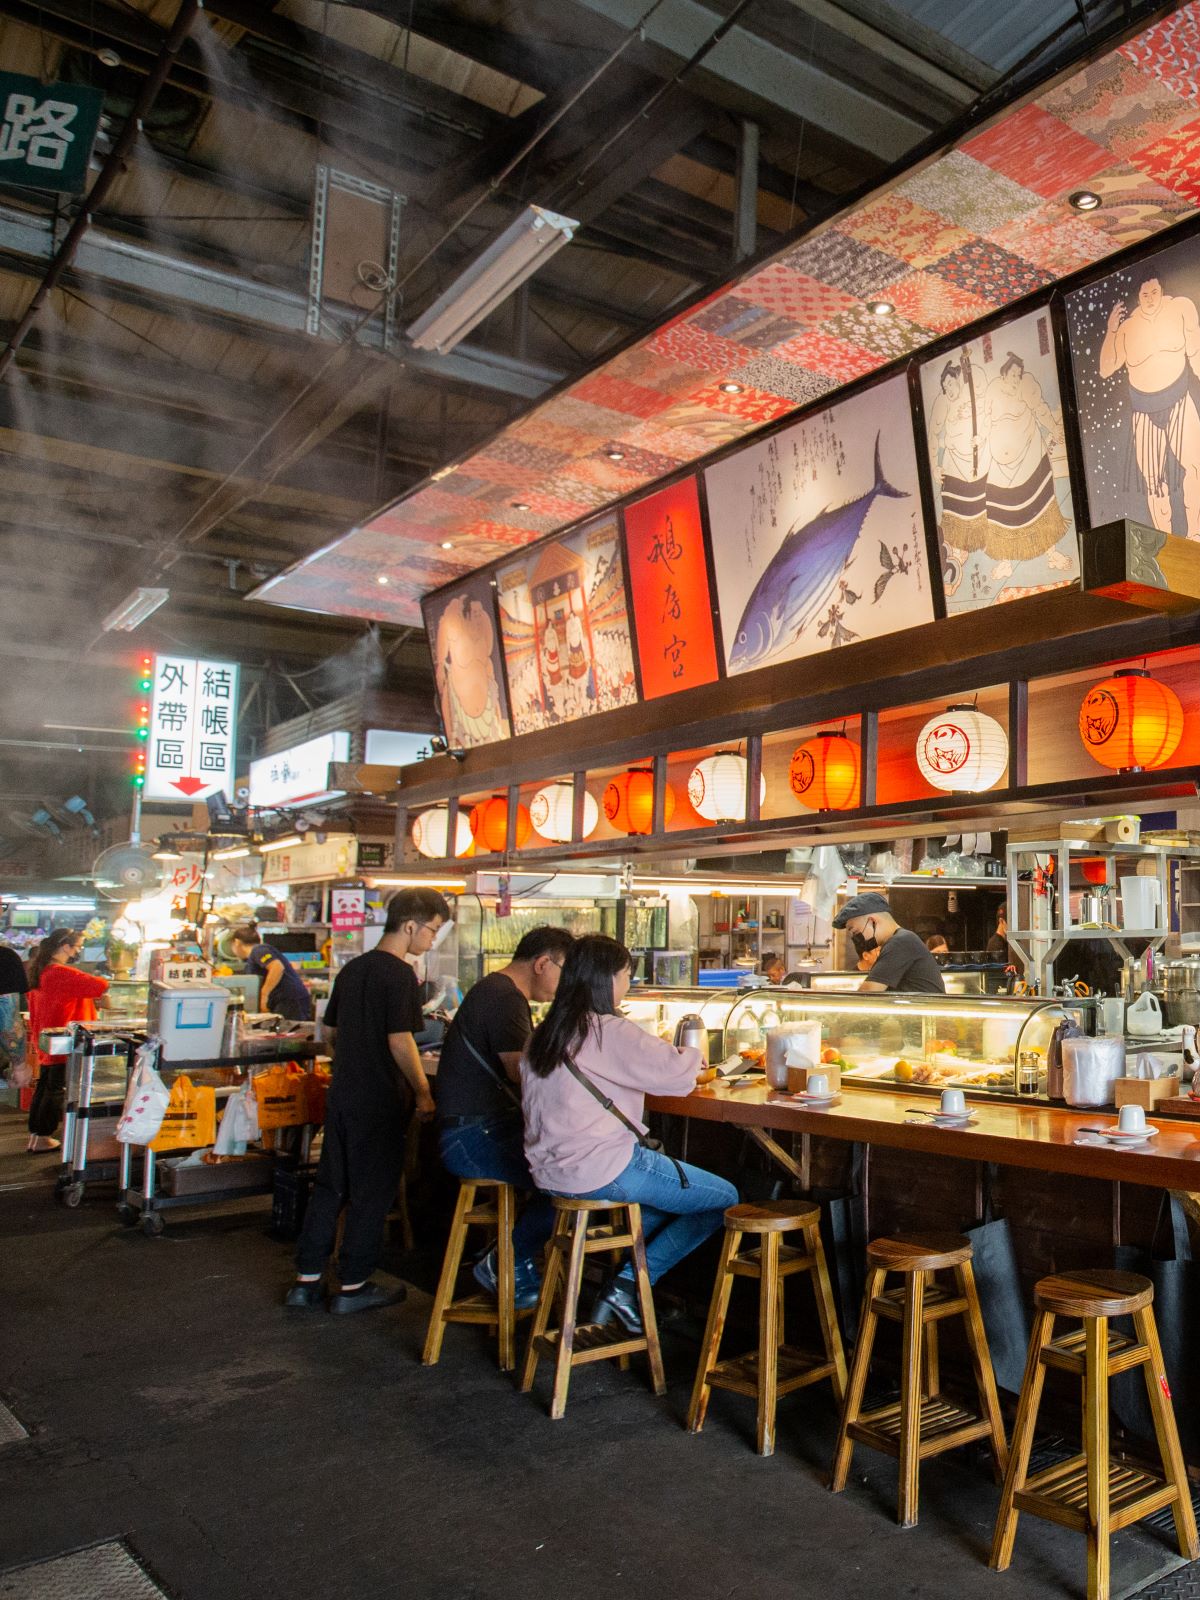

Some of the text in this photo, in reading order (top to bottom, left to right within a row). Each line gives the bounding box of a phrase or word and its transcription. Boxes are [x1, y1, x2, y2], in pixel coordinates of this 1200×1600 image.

[0, 93, 79, 170] 路
[156, 664, 190, 770] 外帶區
[200, 667, 232, 772] 結帳區
